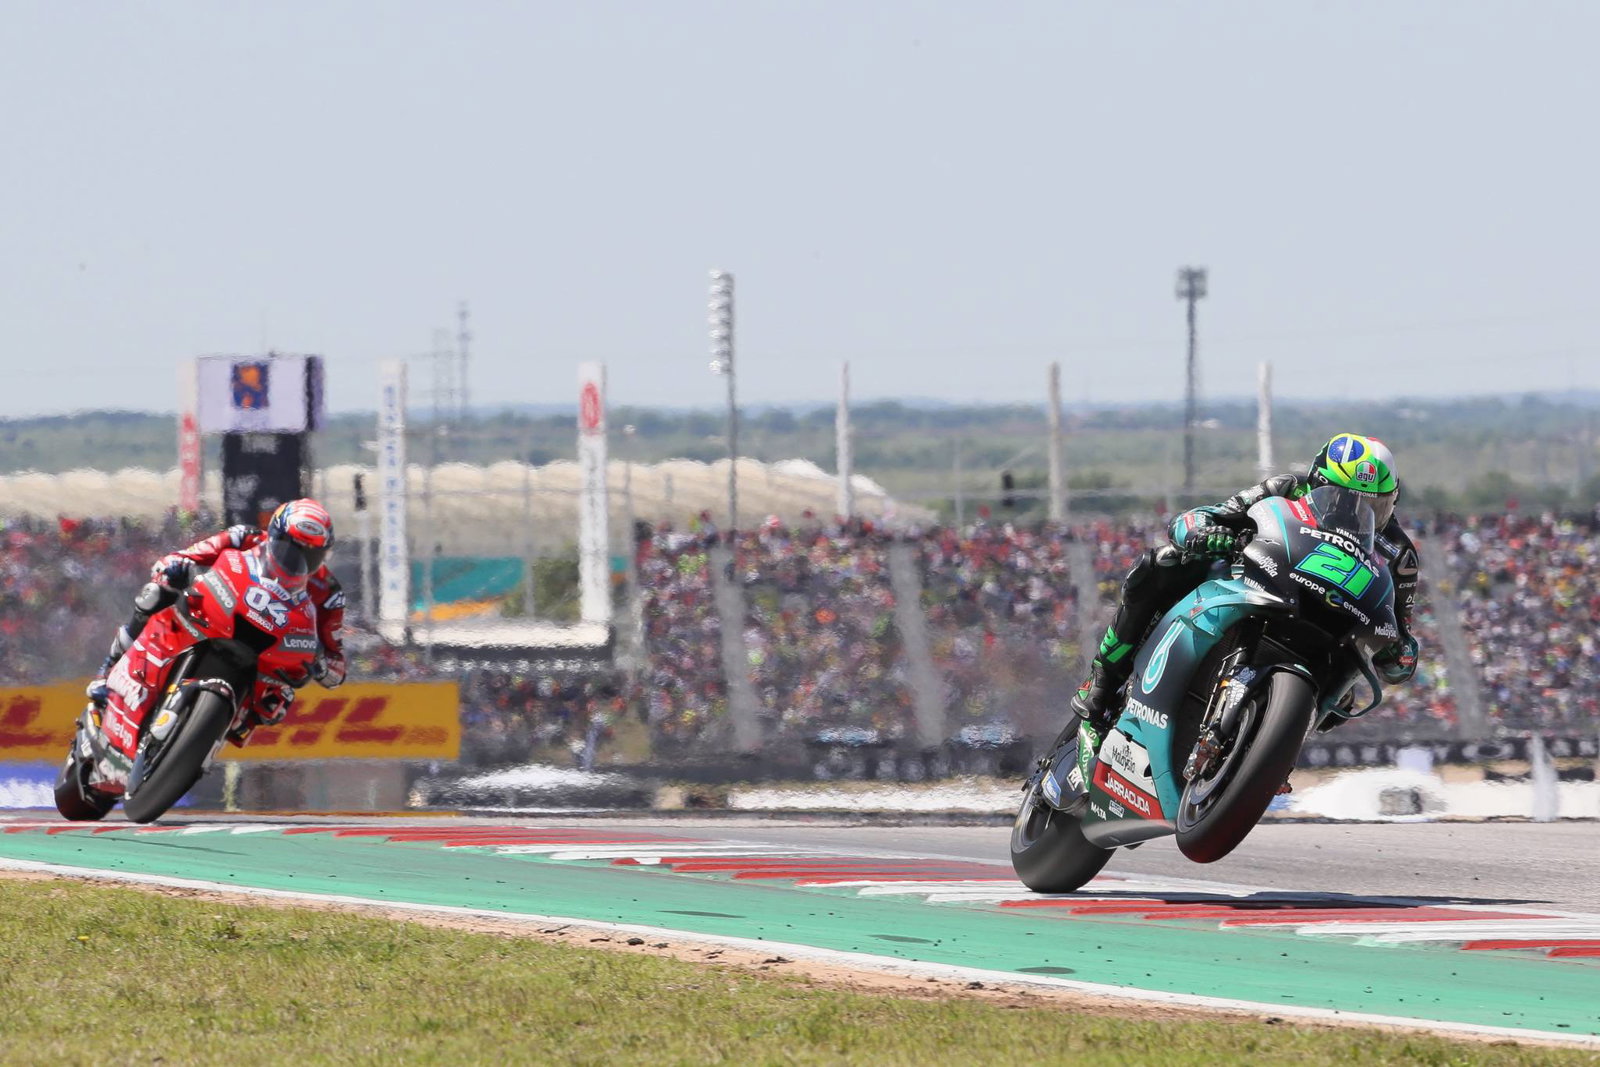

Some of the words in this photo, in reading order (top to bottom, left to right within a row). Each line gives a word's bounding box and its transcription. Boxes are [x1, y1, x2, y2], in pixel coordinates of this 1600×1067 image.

[1300, 526, 1380, 578] PETRONAS
[1335, 527, 1361, 545] YAMAHA
[1294, 542, 1376, 600] 21
[244, 586, 290, 628] 04
[1289, 572, 1326, 595] europe
[1343, 601, 1371, 626] energy
[1126, 696, 1169, 730] PETRONAS
